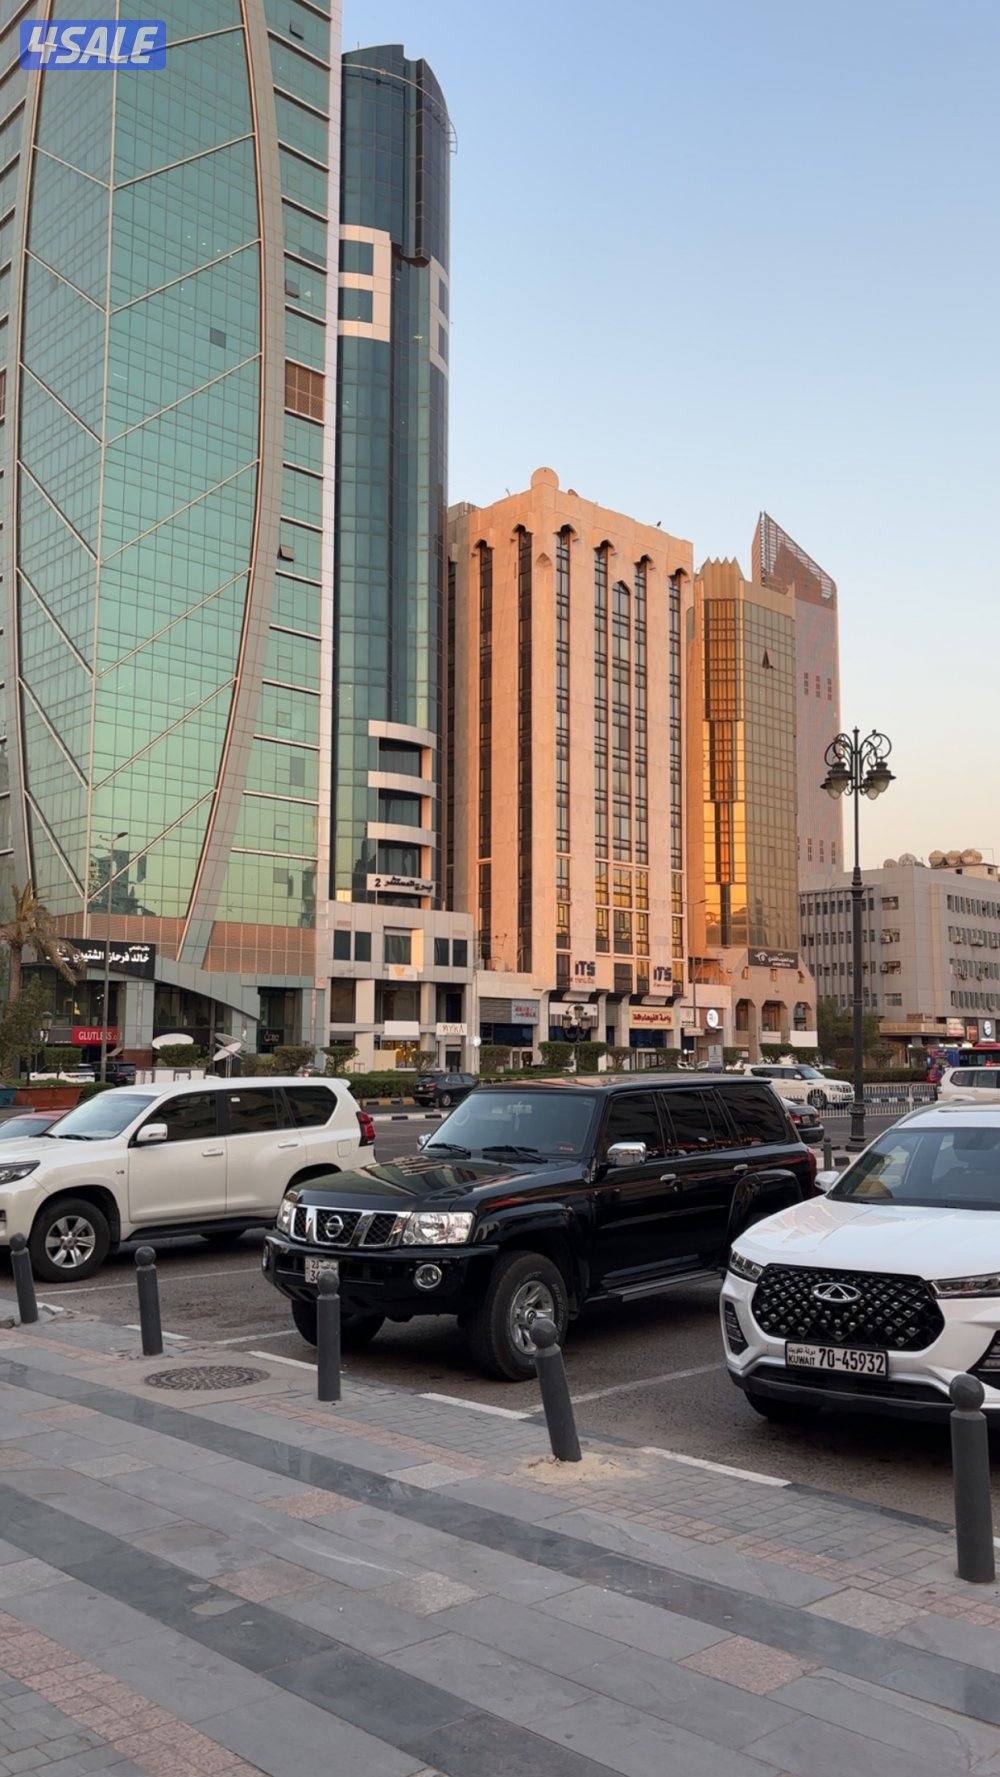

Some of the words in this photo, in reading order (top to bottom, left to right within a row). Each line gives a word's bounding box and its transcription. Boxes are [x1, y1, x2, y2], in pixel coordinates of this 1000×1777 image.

[375, 877, 381, 888] 2
[131, 953, 150, 963] خالد
[788, 1355, 815, 1366] KUWAIT
[819, 1348, 885, 1374] 70-45932
